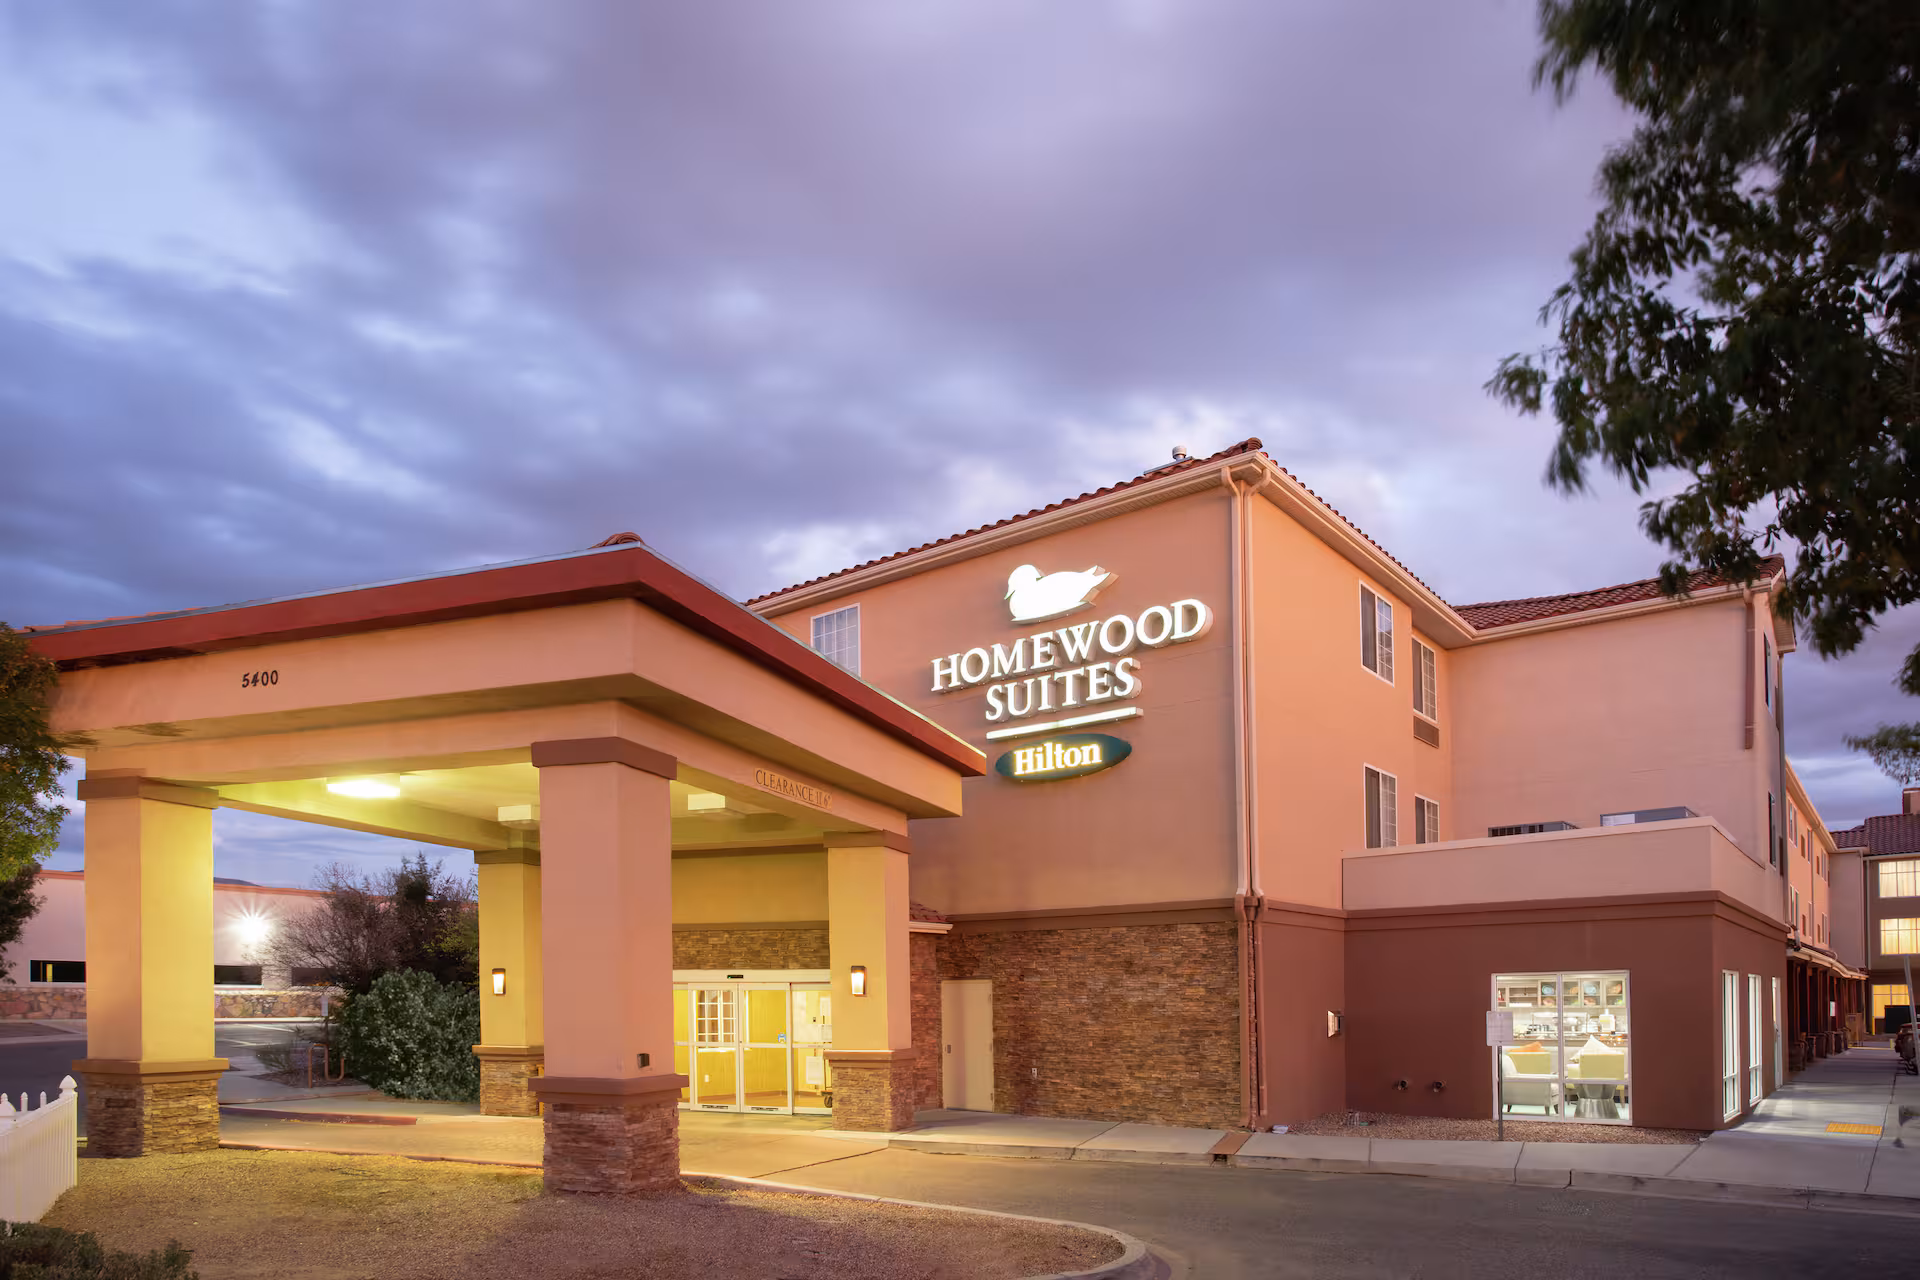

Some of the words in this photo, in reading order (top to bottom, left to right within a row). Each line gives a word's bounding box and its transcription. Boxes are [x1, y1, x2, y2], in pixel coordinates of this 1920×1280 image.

[931, 599, 1211, 691] HOMEWOOD
[242, 670, 278, 688] 5400
[985, 657, 1140, 722] SUITES
[1012, 742, 1102, 776] Hilton
[756, 769, 813, 802] CLEARANCE
